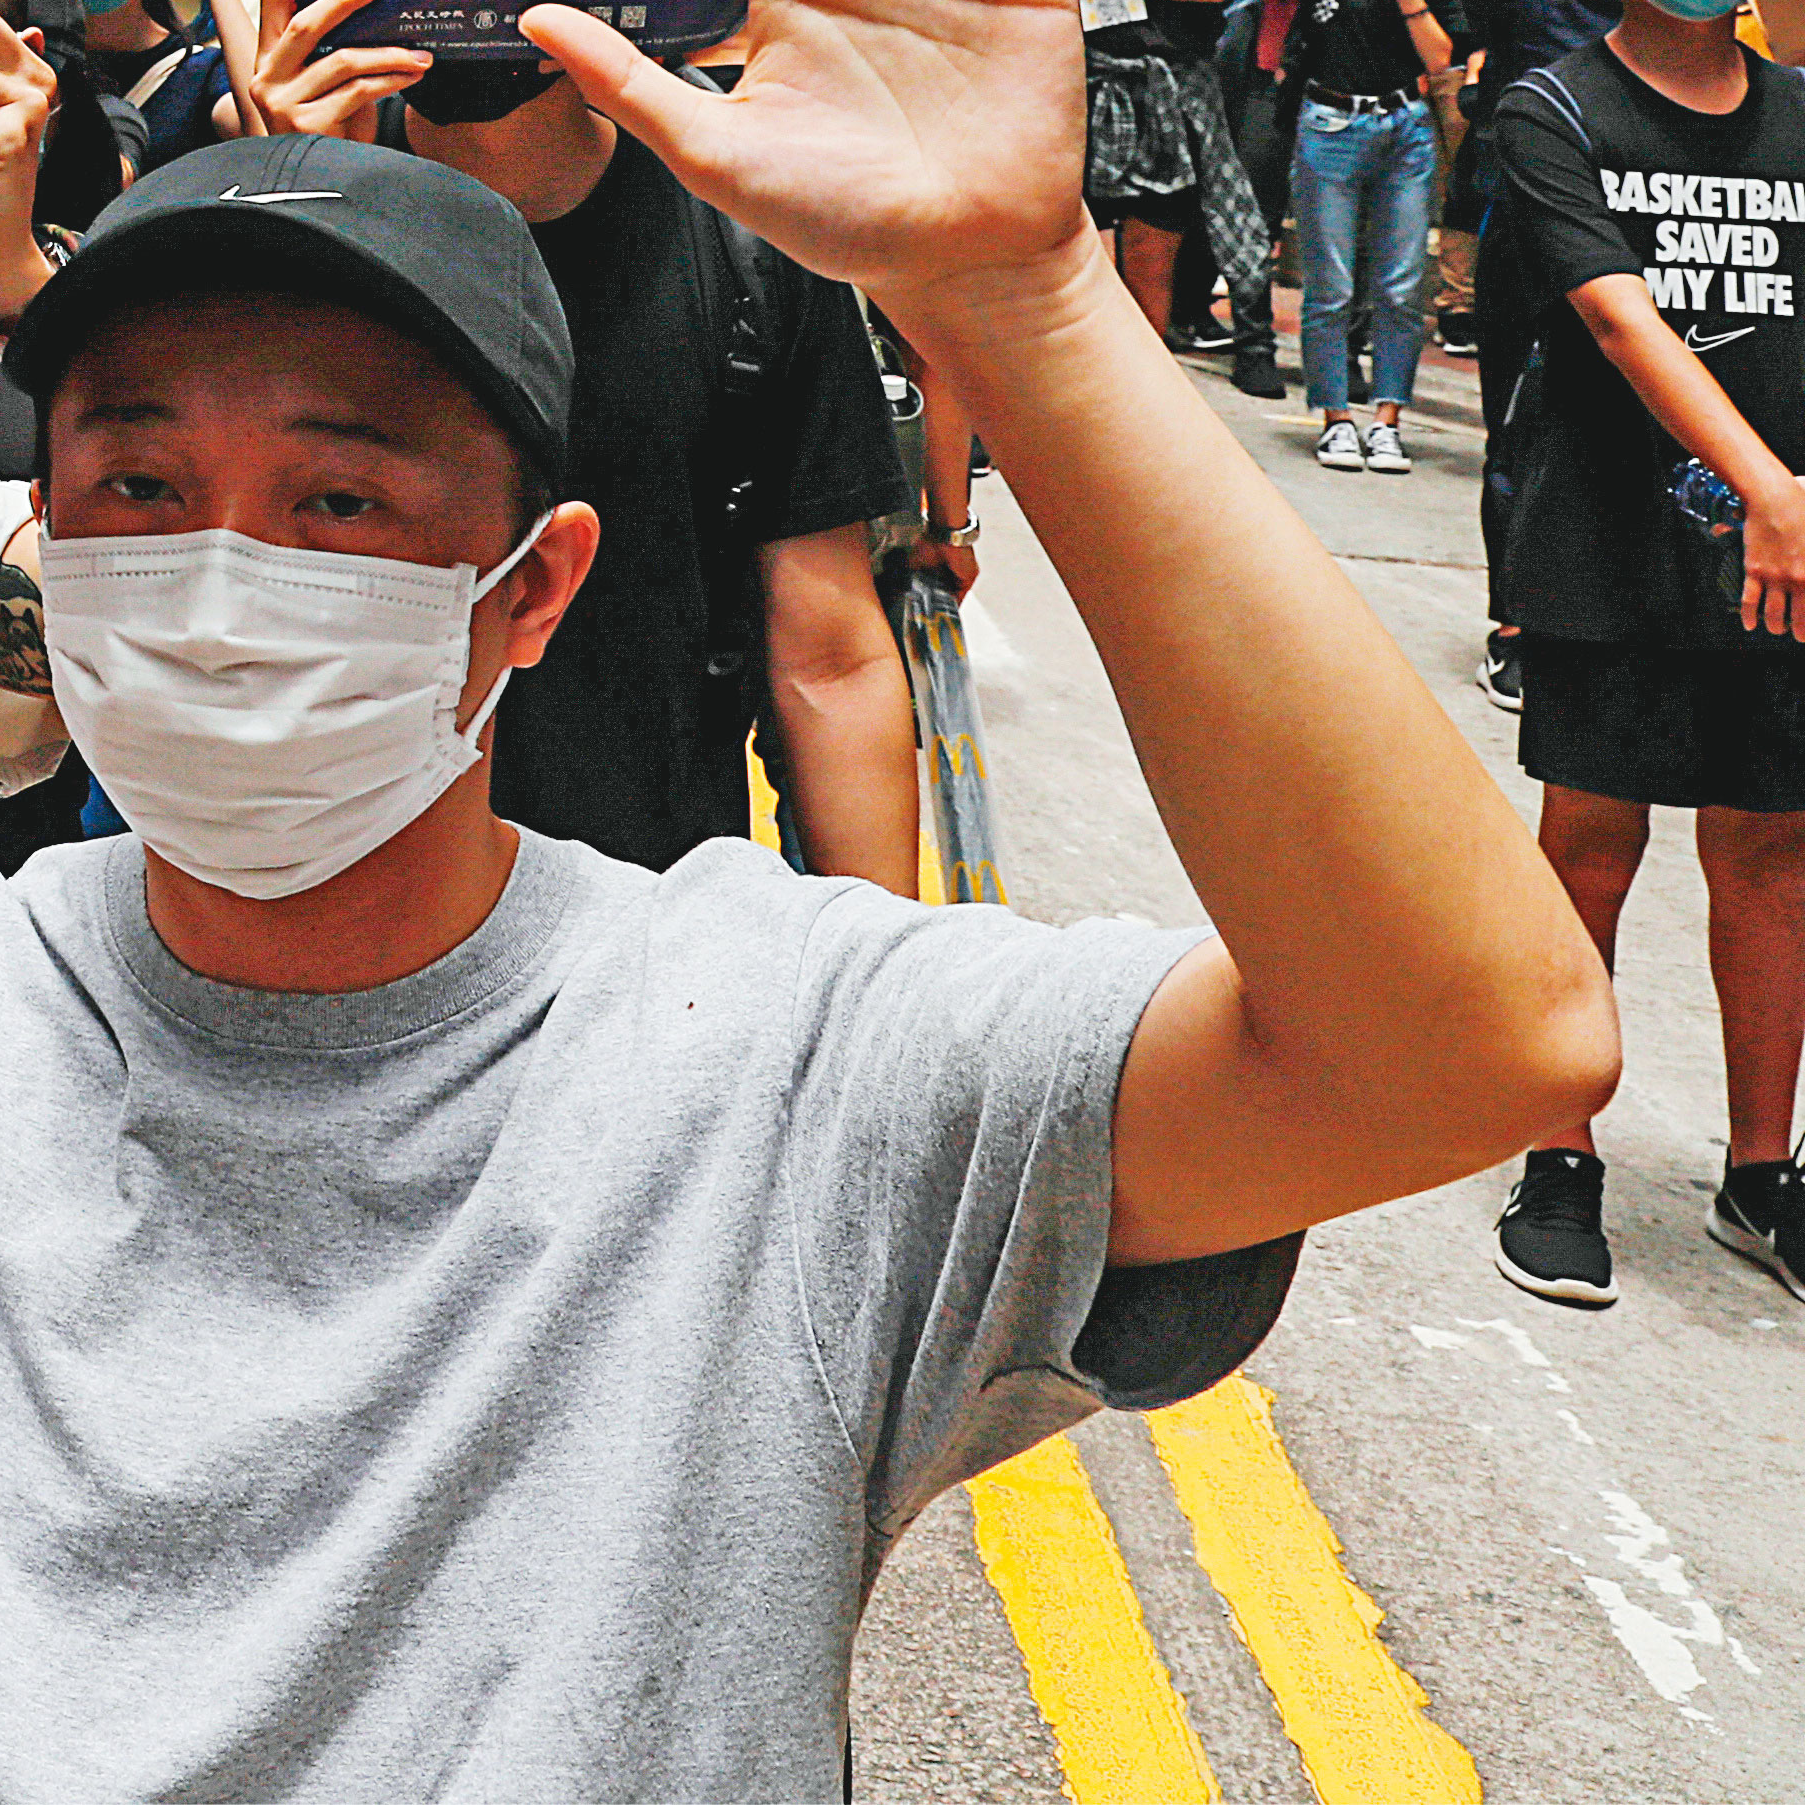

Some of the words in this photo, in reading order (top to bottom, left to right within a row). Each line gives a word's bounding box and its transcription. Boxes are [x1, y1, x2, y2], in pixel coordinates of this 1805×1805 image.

[1655, 219, 1780, 268] SAVED
[1643, 267, 1715, 310] MY
[1724, 271, 1795, 316] LIFE
